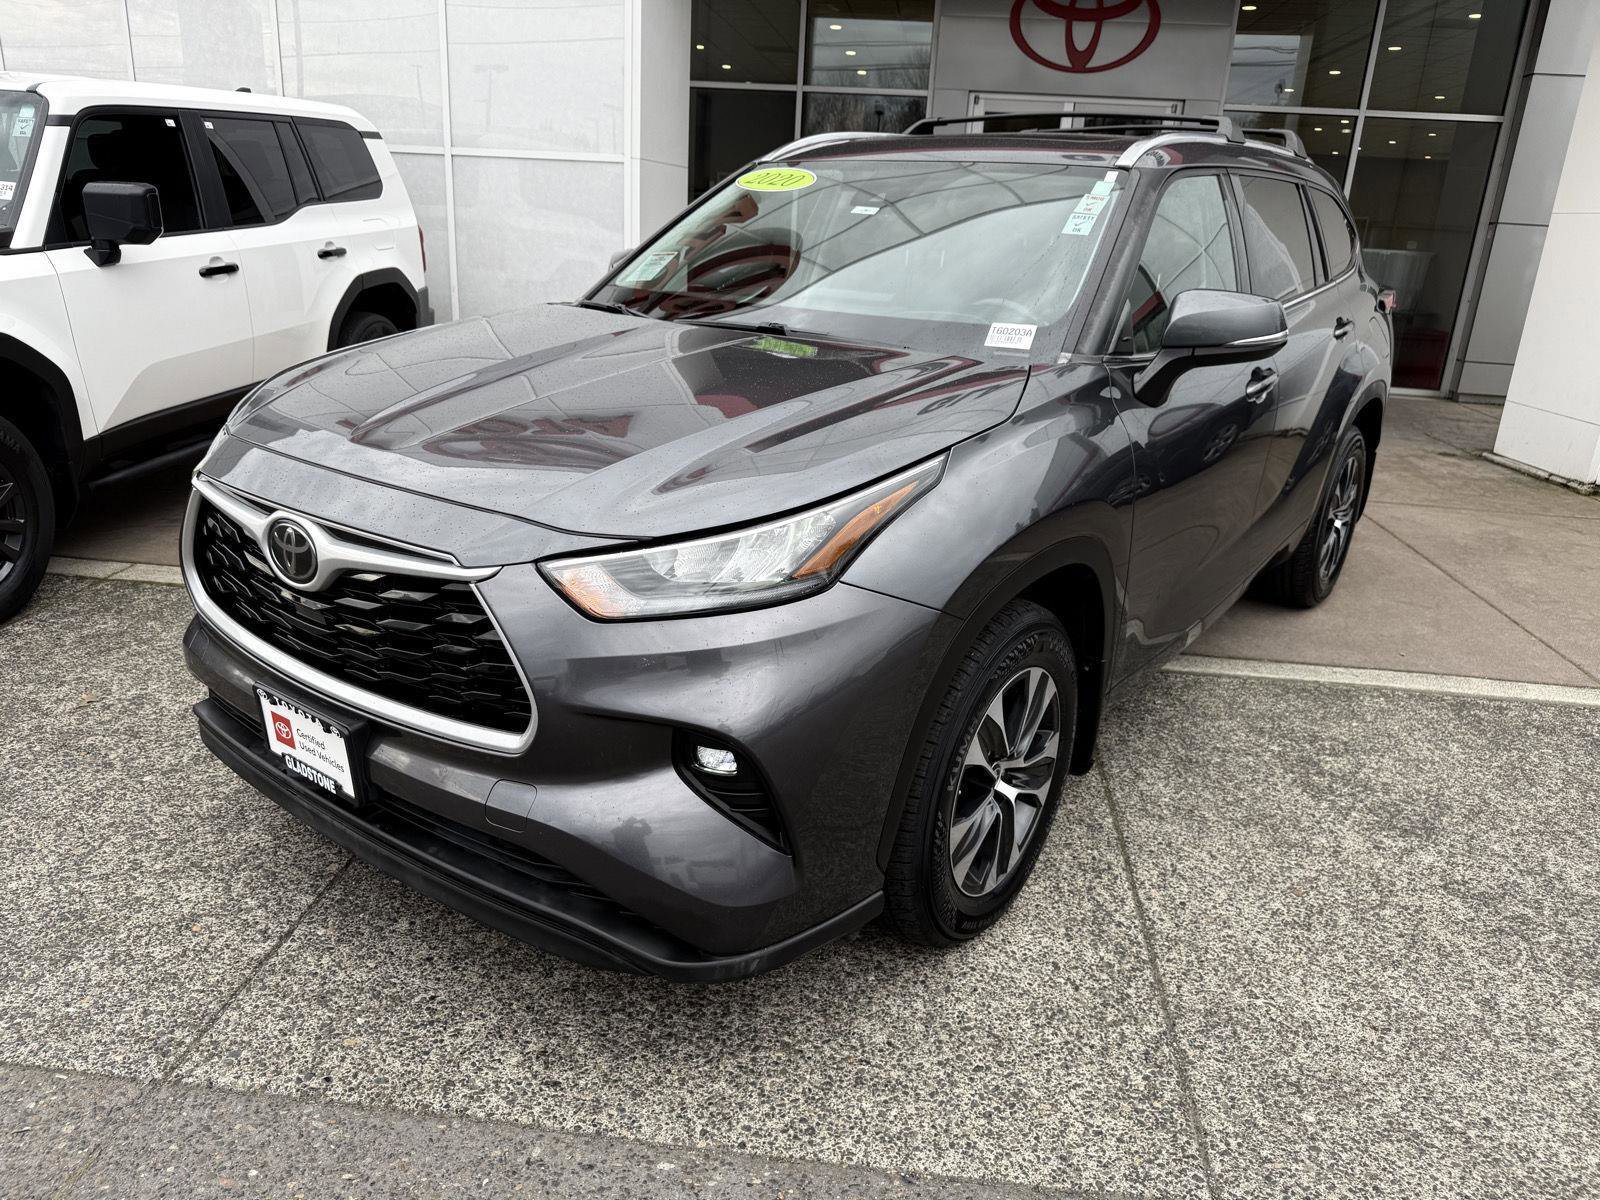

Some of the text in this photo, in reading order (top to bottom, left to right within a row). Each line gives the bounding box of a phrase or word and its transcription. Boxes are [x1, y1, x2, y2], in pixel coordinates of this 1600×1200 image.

[745, 172, 805, 187] 2020
[296, 728, 325, 750] Certified
[299, 740, 345, 773] Used Vehicles
[285, 754, 337, 794] GLADSTONE
